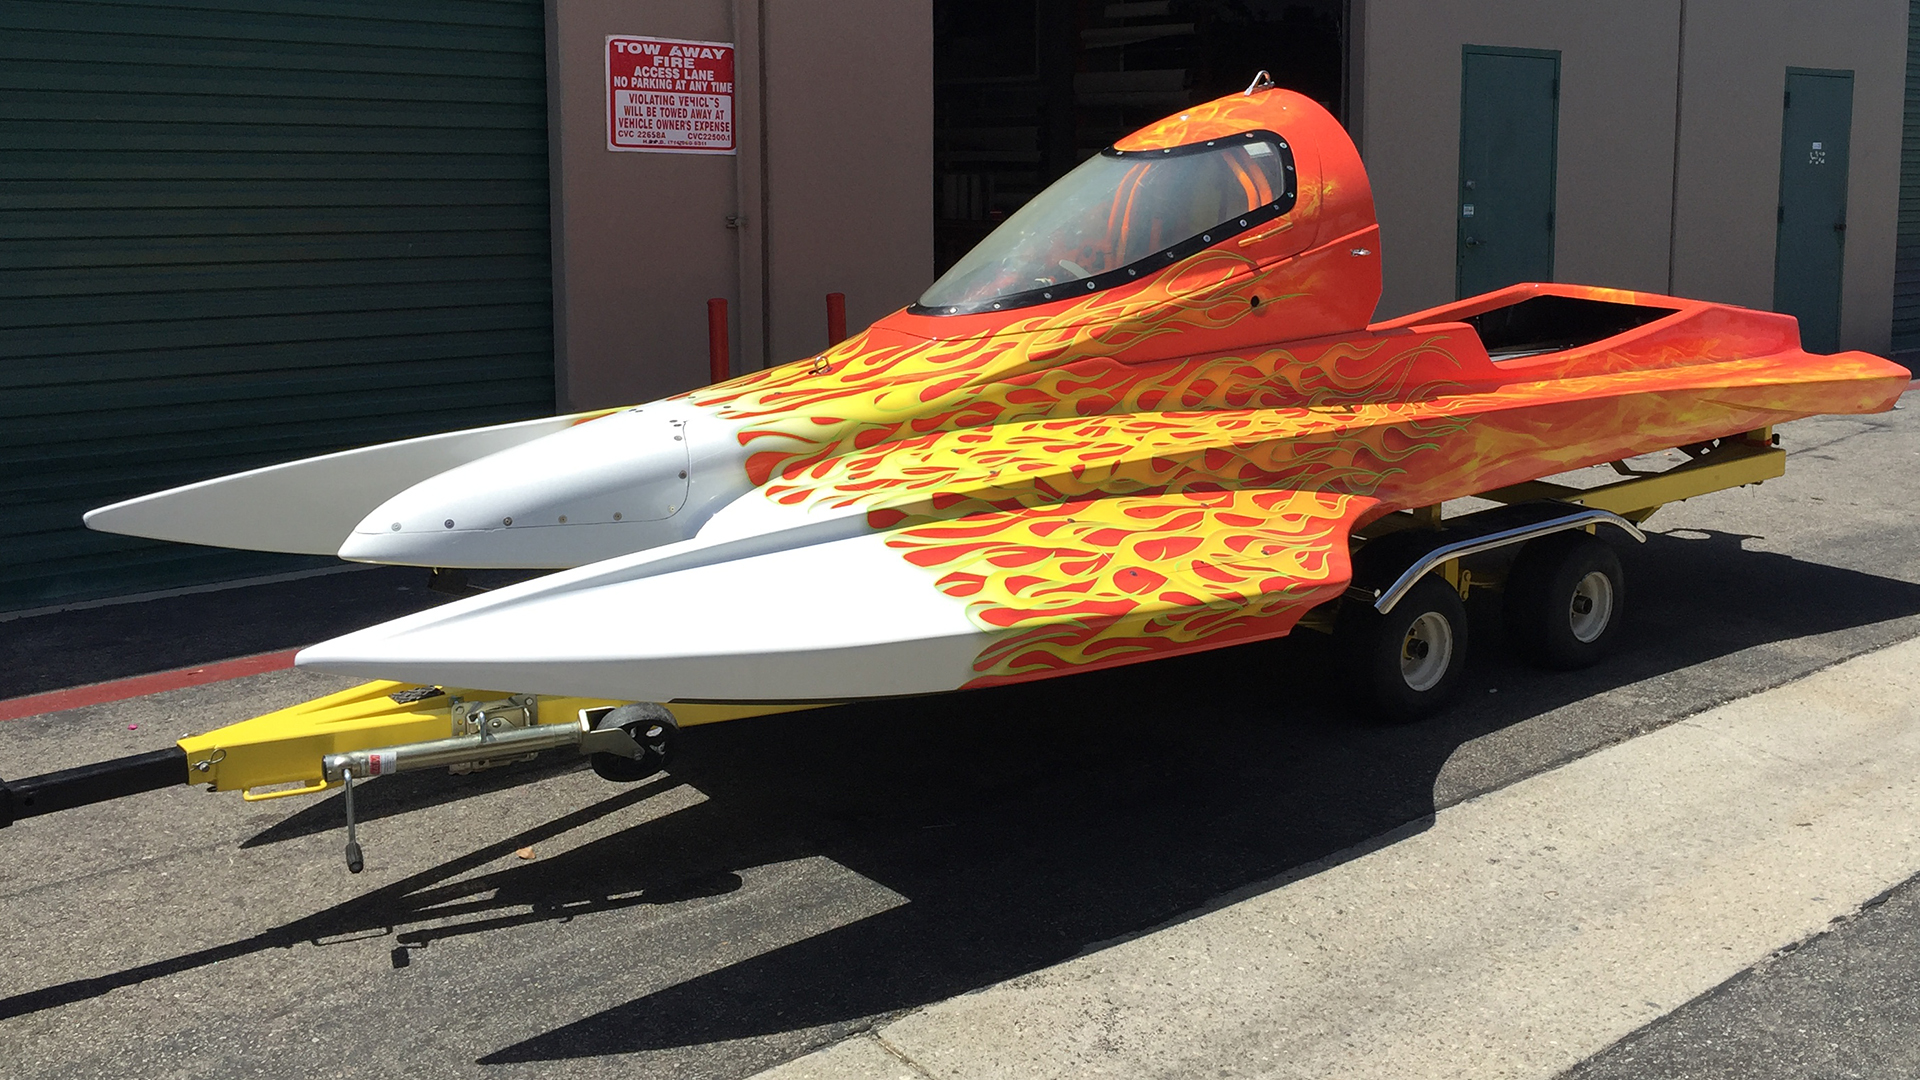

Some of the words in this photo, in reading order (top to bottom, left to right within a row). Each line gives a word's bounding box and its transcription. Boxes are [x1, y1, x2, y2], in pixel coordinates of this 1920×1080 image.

[614, 42, 661, 54] TOW
[669, 46, 725, 59] AWAY
[654, 56, 695, 68] FIRE
[634, 66, 680, 79] ACCESS
[685, 70, 714, 81] LANE
[614, 76, 628, 87] NO
[631, 78, 672, 90] PARKING
[676, 80, 686, 90] AT
[689, 81, 707, 92] ANY
[711, 82, 732, 93] TIME
[629, 94, 675, 106] VIOLATING
[624, 106, 643, 117] WILL
[647, 107, 656, 117] BE
[660, 108, 687, 118] TOWED
[691, 110, 712, 119] AWAY
[715, 111, 724, 120] AT
[618, 118, 652, 129] VEHICLE
[695, 123, 729, 132] EXPENSE
